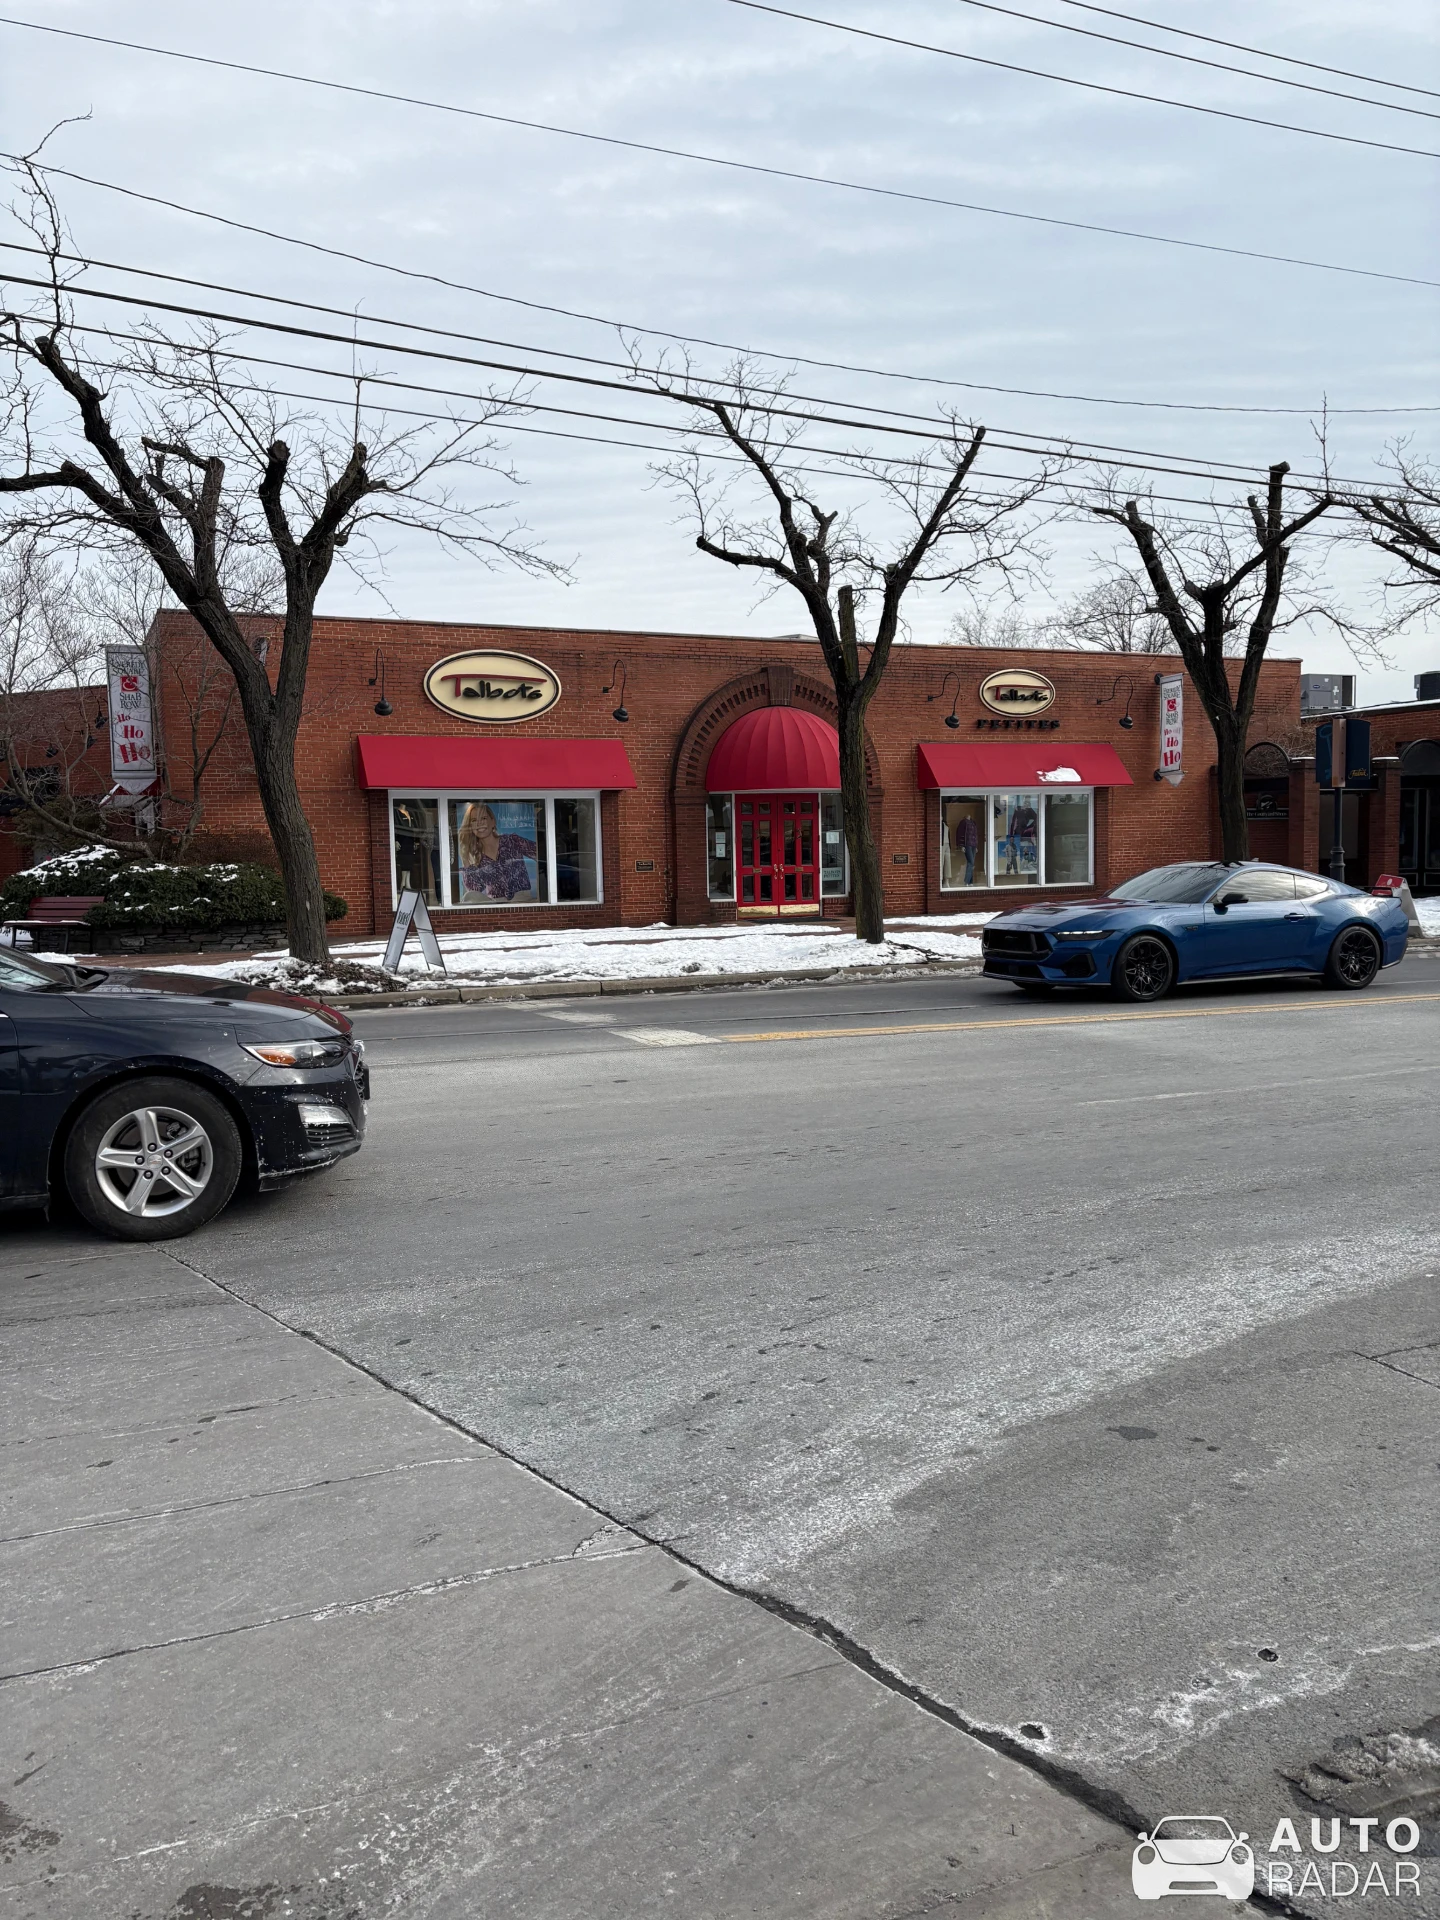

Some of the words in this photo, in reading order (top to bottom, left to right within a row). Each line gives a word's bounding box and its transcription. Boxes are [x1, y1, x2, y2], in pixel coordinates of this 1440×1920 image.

[441, 673, 547, 699] Talbots
[119, 692, 142, 701] SHAB
[986, 684, 1051, 701] Talbots
[120, 700, 141, 709] ROW
[117, 713, 131, 722] Ho
[977, 719, 1060, 729] PETITES
[123, 725, 144, 738] Ho
[1166, 737, 1179, 748] Ho
[120, 742, 151, 764] Ho
[1163, 750, 1181, 767] Ho
